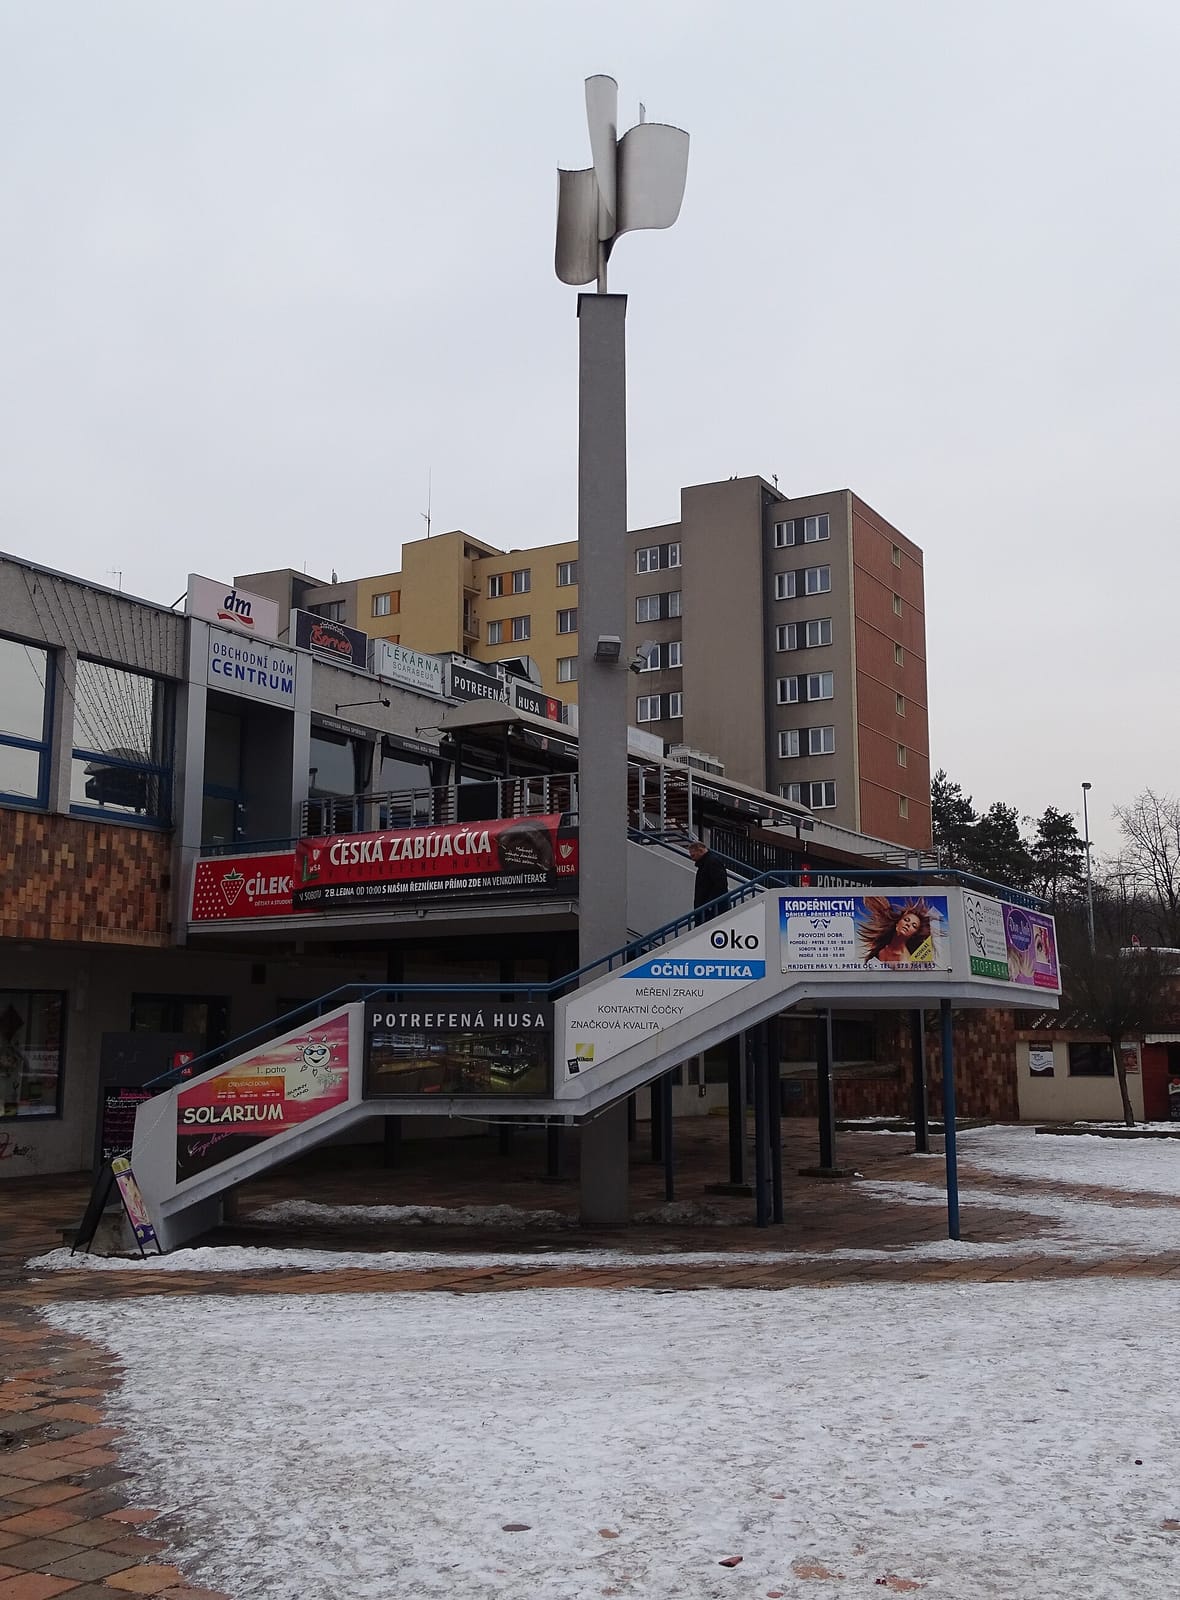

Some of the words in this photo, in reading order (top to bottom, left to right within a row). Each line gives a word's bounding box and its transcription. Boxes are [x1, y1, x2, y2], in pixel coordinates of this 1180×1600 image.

[223, 590, 252, 617] dm
[212, 642, 268, 669] OBCHODNÍ
[272, 658, 294, 676] DŮM
[387, 646, 440, 674] LÉKÁRNA
[211, 658, 293, 694] CENTRUM
[392, 661, 434, 681] SCARABEUS
[454, 675, 504, 702] POTREFENÁ
[518, 695, 540, 714] HUSA
[330, 835, 385, 866] ČESKÁ
[388, 827, 491, 861] ZABÍJAČKA
[556, 864, 575, 873] HUSA
[356, 887, 365, 896] OD
[382, 884, 387, 894] S
[387, 881, 409, 893] NAŠIM
[409, 879, 444, 892] ŘEZNÍKEM
[444, 877, 468, 890] PŘÍMO
[468, 877, 482, 888] ZDE
[482, 877, 491, 887] NA
[491, 873, 523, 886] VENKOVNÍ
[524, 872, 547, 883] TERASE
[785, 898, 855, 911] KADEŘNICTVÍ
[710, 929, 759, 950] Oko
[650, 962, 689, 977] OČNÍ
[693, 964, 753, 977] OPTIKA
[635, 988, 671, 997] MĚŘENÍ
[673, 989, 704, 998] ZRAKU
[373, 1009, 485, 1028] POTREFENÁ
[493, 1013, 545, 1028] HUSA
[598, 1004, 649, 1015] KONTAKTNÍ
[651, 1004, 684, 1015] ČOČKY
[570, 1019, 620, 1030] ZNAČKOVÁ
[623, 1021, 660, 1030] KVALITA
[265, 1066, 287, 1075] patro
[183, 1103, 284, 1125] SOLARIUM
